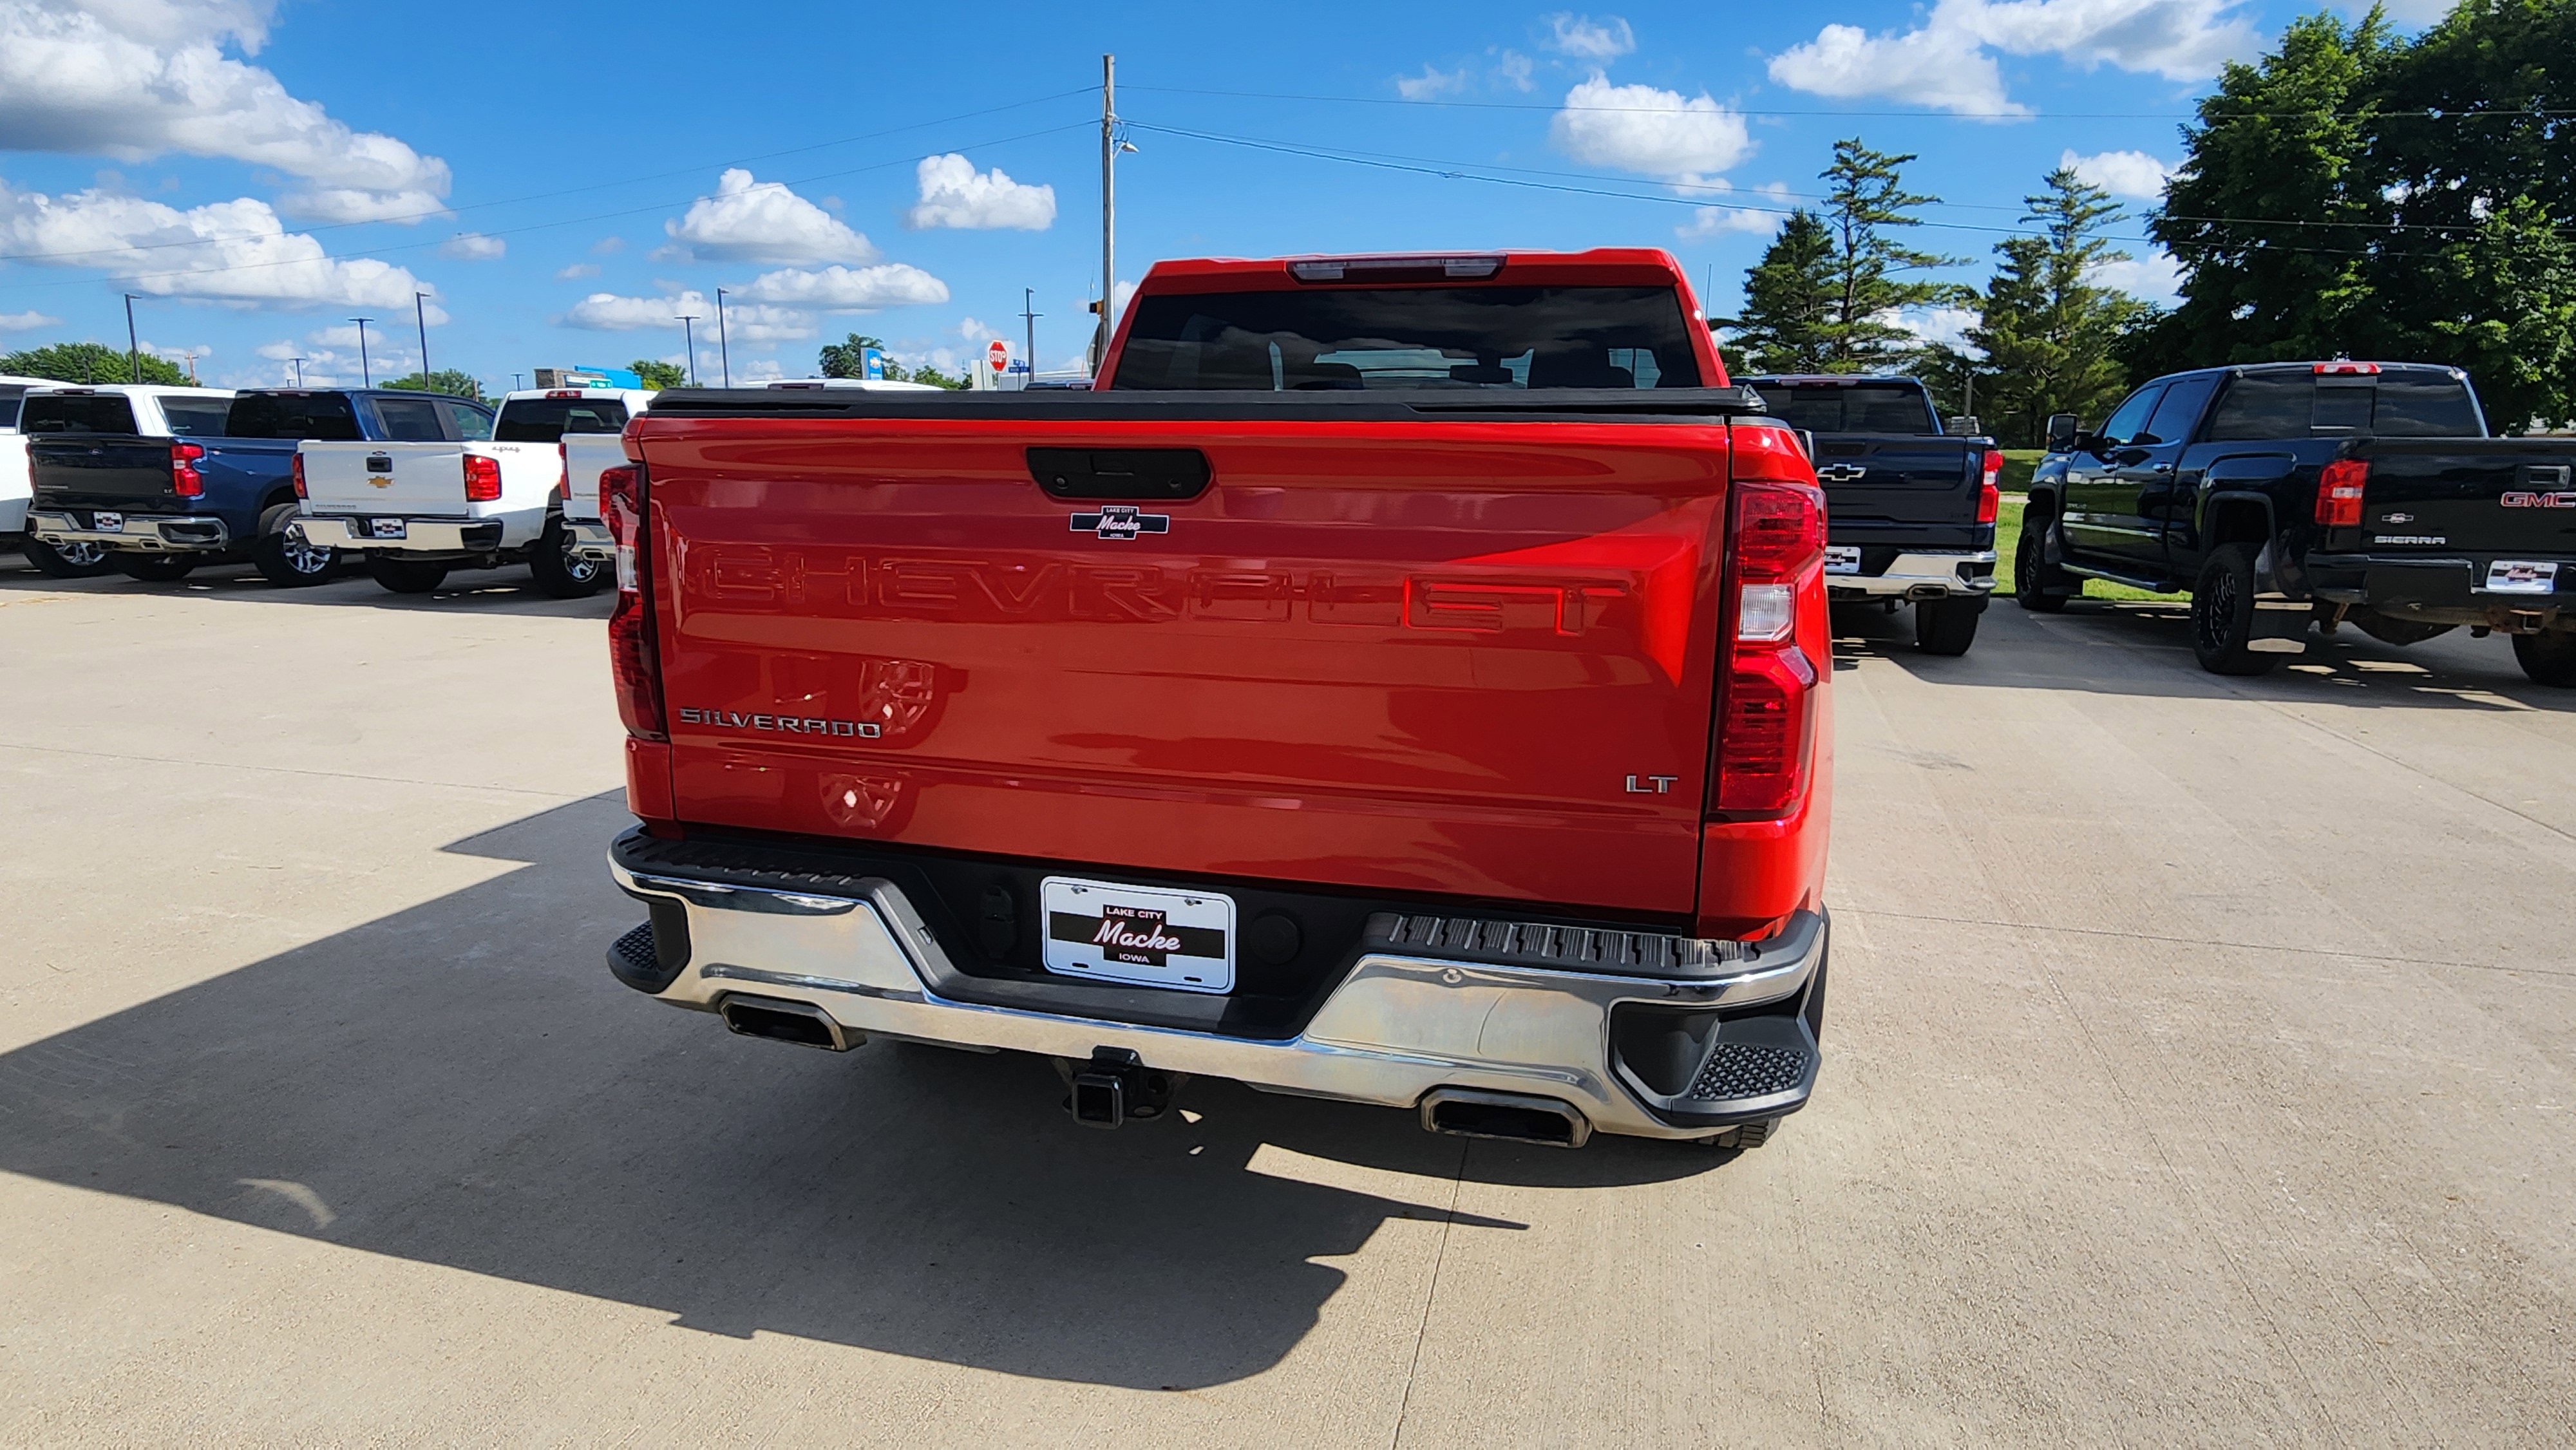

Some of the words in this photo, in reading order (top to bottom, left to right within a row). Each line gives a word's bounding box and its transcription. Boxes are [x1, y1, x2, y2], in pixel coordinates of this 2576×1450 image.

[990, 350, 1006, 363] STOP
[2500, 491, 2576, 508] GMC
[1095, 515, 1141, 531] Macke
[2374, 535, 2446, 545] SIERRA
[699, 551, 1629, 636] CHEVROLET
[679, 708, 881, 739] SILVERADO
[1626, 775, 1678, 793] LT
[1106, 907, 1135, 917] LAKE
[1138, 910, 1163, 919] CITY
[1093, 919, 1181, 950] Macke
[1119, 952, 1150, 963] IOWA
